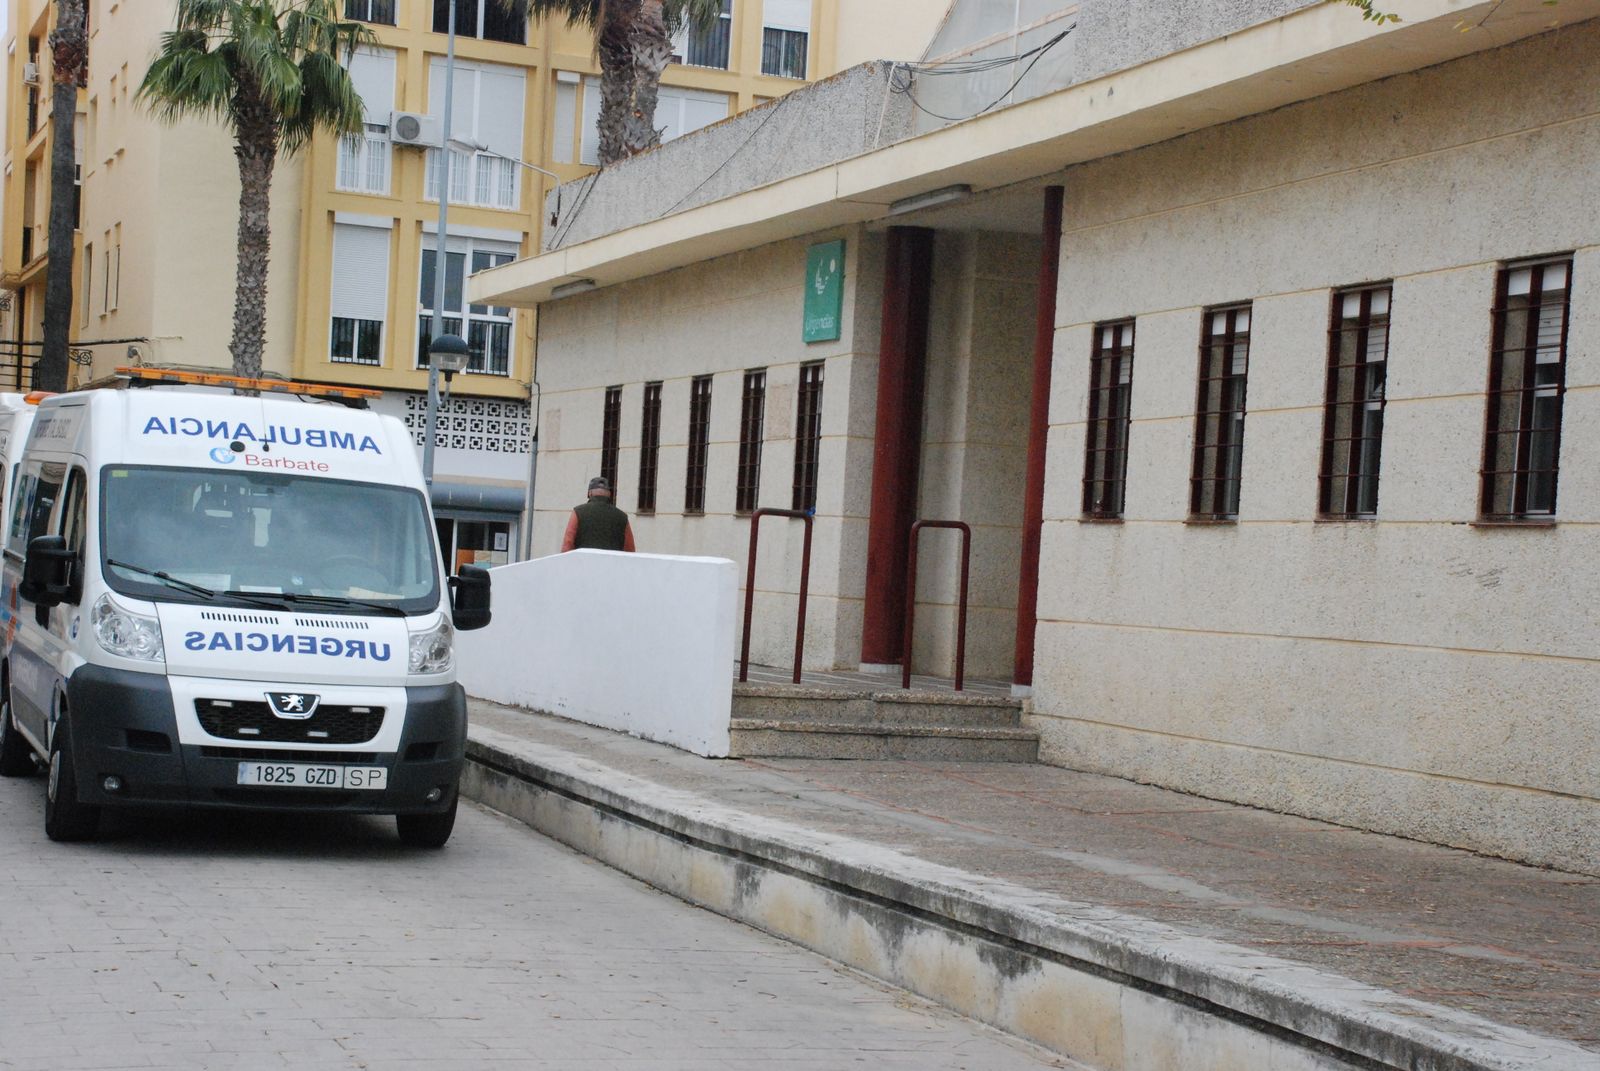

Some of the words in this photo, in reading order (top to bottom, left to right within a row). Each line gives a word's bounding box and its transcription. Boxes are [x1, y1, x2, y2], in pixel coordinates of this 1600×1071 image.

[245, 454, 329, 473] Barbate
[255, 766, 296, 784] 1825
[305, 769, 337, 786] GZD
[350, 770, 383, 788] SP
